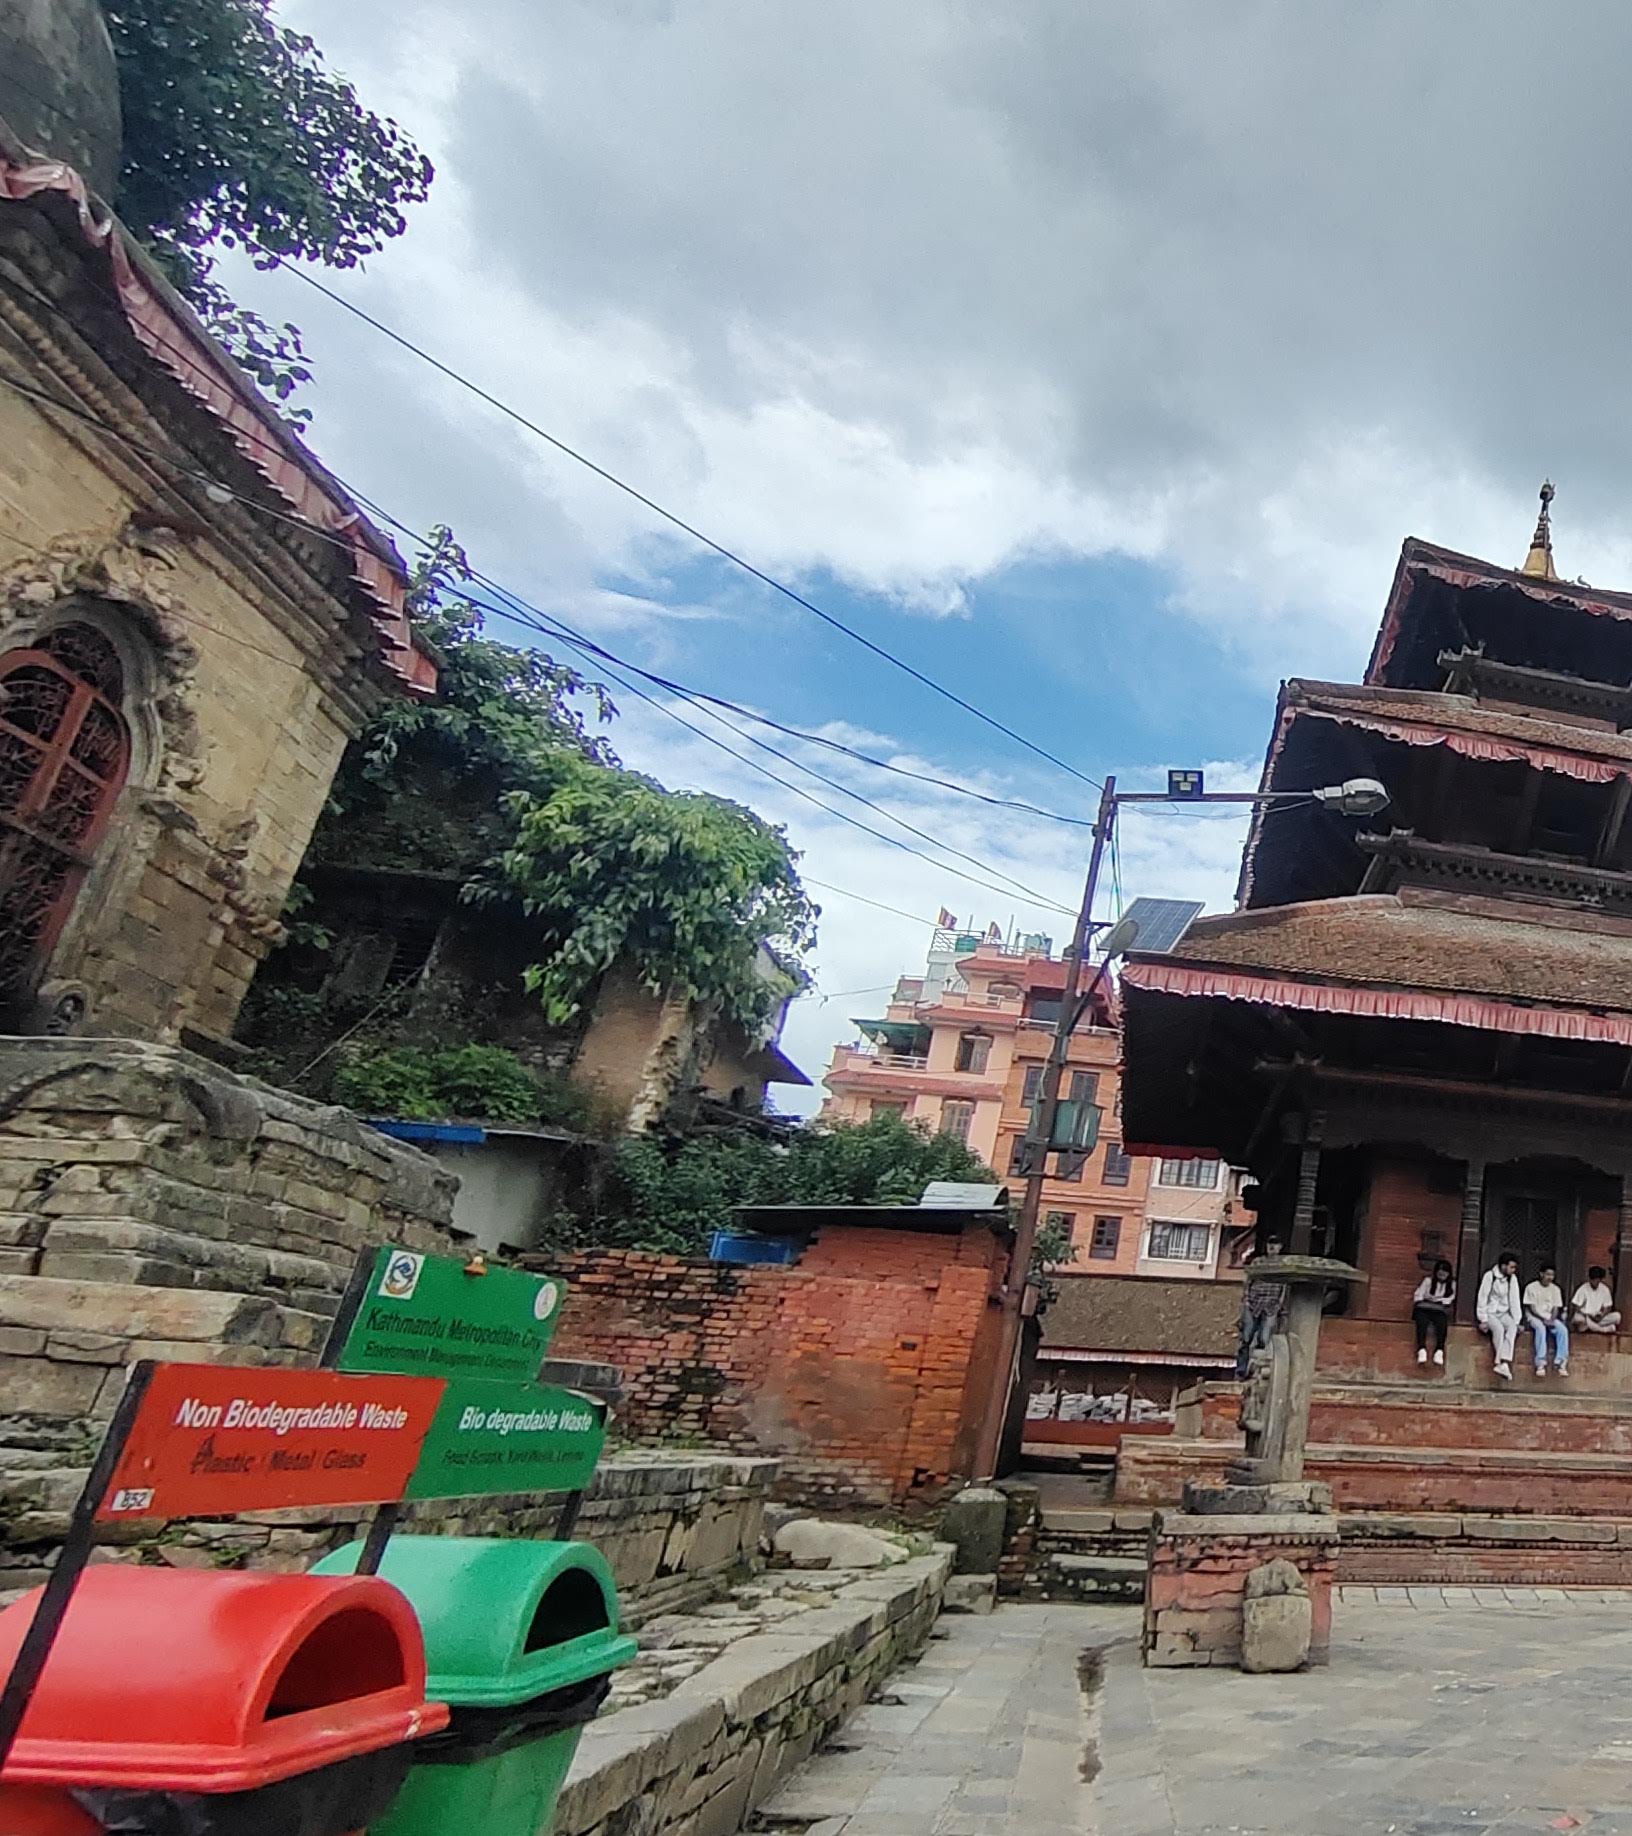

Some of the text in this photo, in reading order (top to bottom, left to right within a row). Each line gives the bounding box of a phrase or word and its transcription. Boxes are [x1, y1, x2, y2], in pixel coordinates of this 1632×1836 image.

[366, 1307, 542, 1352] Kathmandu Metropolitan City
[175, 1398, 409, 1435] Non Biodegradable Waste
[458, 1405, 593, 1436] Bio degradable Waste
